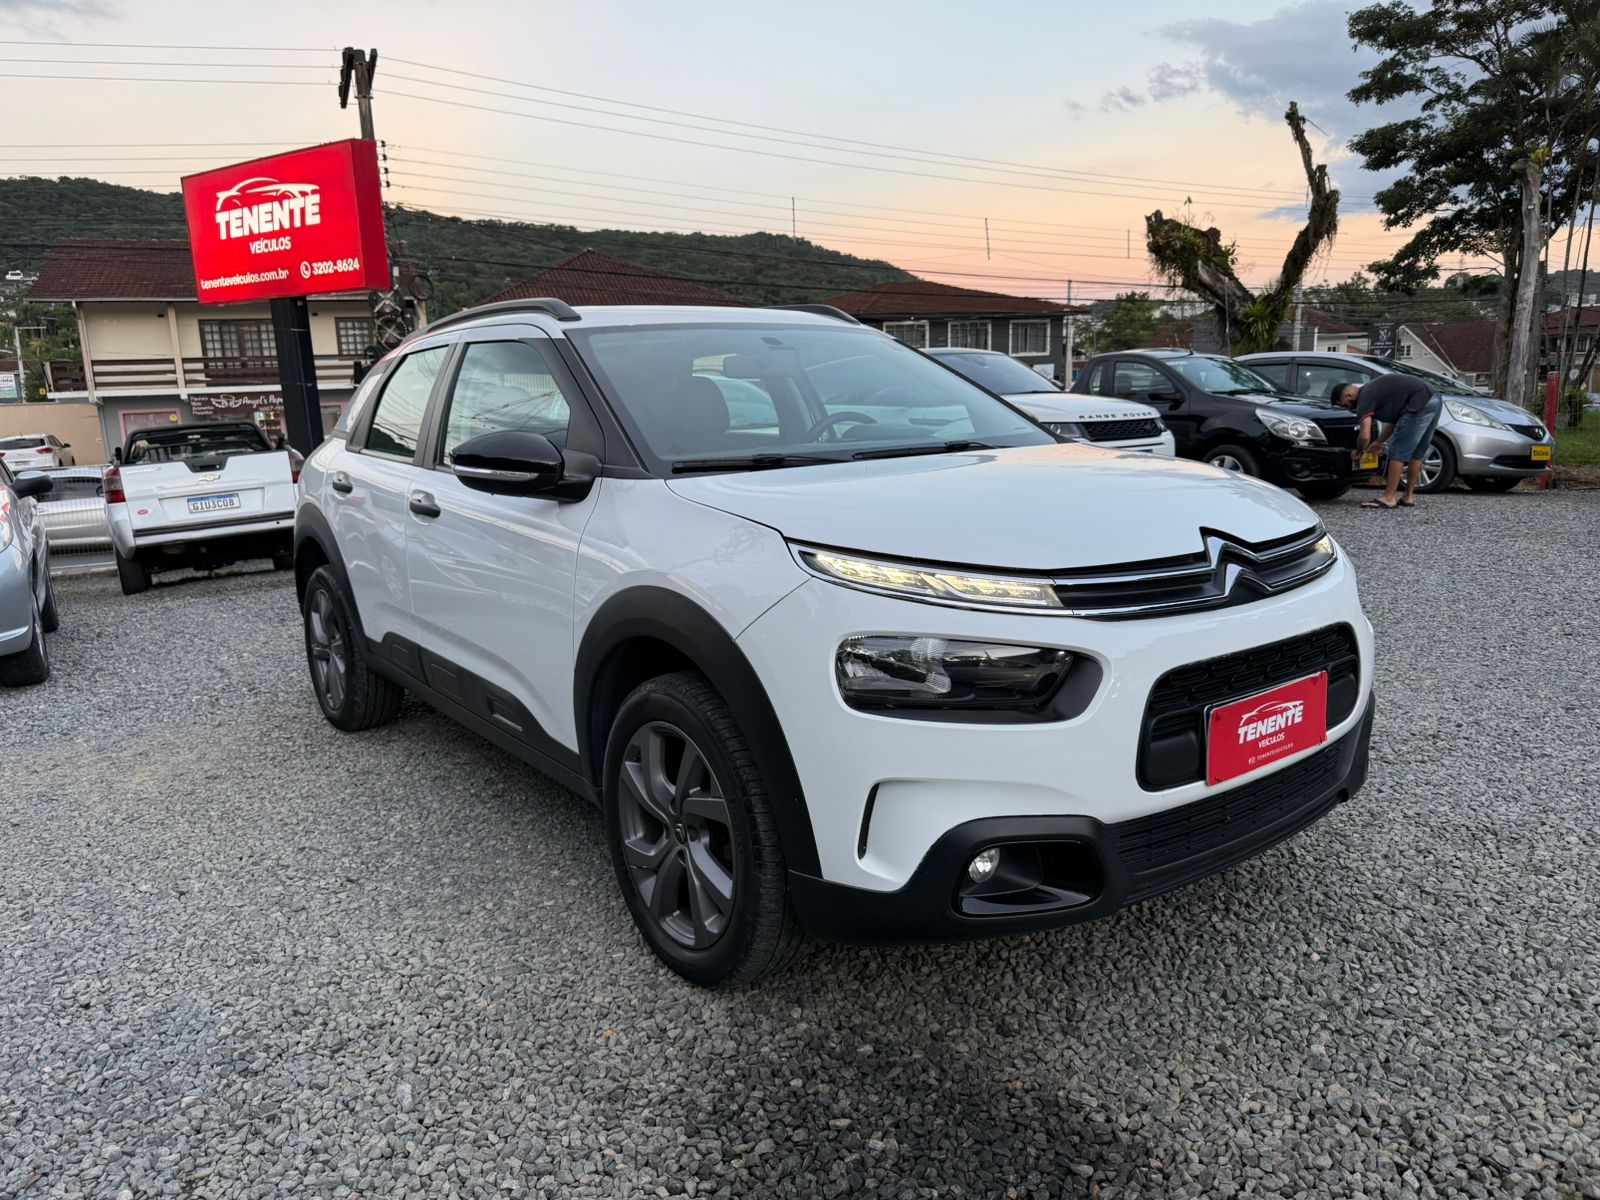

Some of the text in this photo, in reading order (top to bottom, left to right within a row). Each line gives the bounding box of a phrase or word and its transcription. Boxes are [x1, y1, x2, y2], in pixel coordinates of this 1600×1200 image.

[215, 193, 321, 241] TENENTE
[249, 236, 292, 255] VEÍCULOS
[311, 257, 360, 276] 3202-8624
[200, 268, 290, 290] tenenteveiculos.com.br
[1237, 705, 1304, 745] TENENTE
